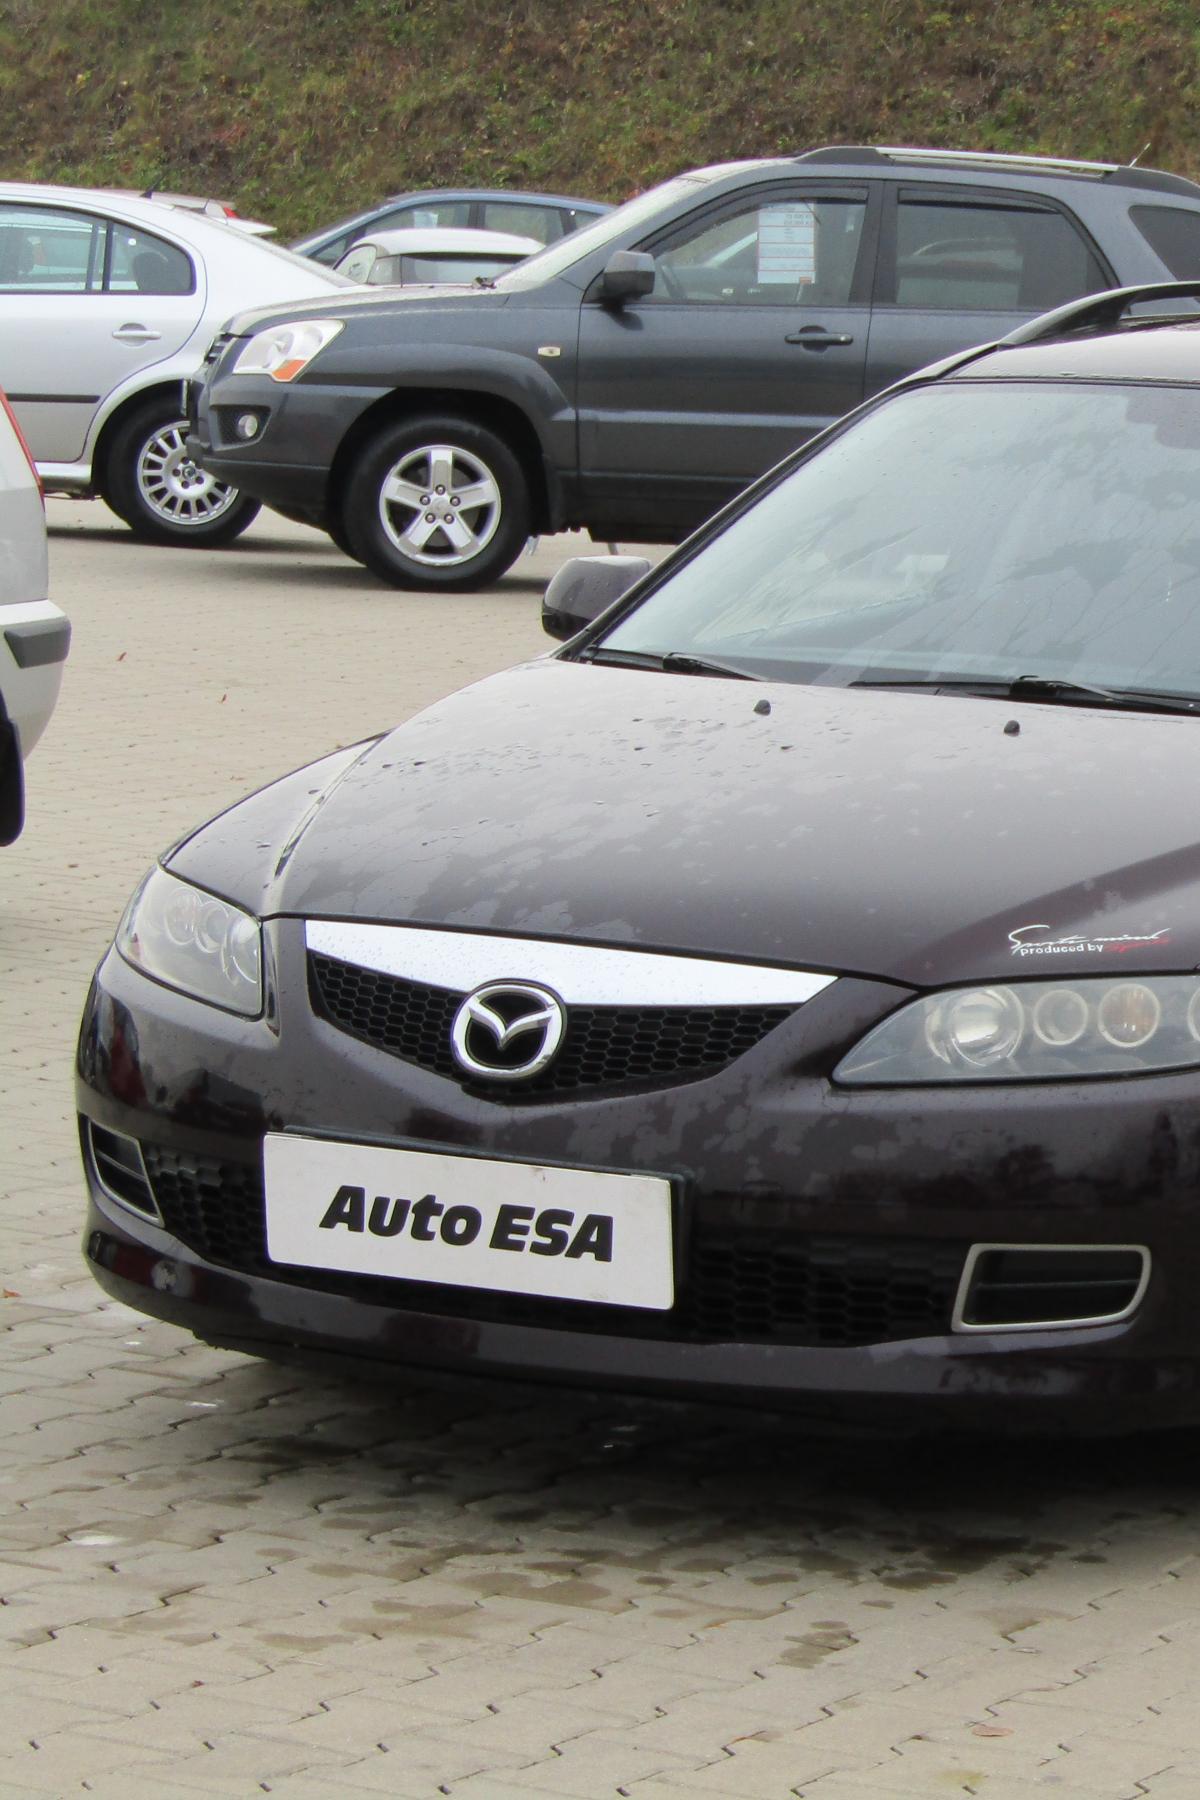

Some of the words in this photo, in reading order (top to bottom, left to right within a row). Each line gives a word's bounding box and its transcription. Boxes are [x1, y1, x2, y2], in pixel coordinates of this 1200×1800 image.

[1020, 943, 1085, 957] produced
[1086, 942, 1105, 953] by
[318, 1184, 482, 1246] Auto
[488, 1203, 614, 1263] ESA
